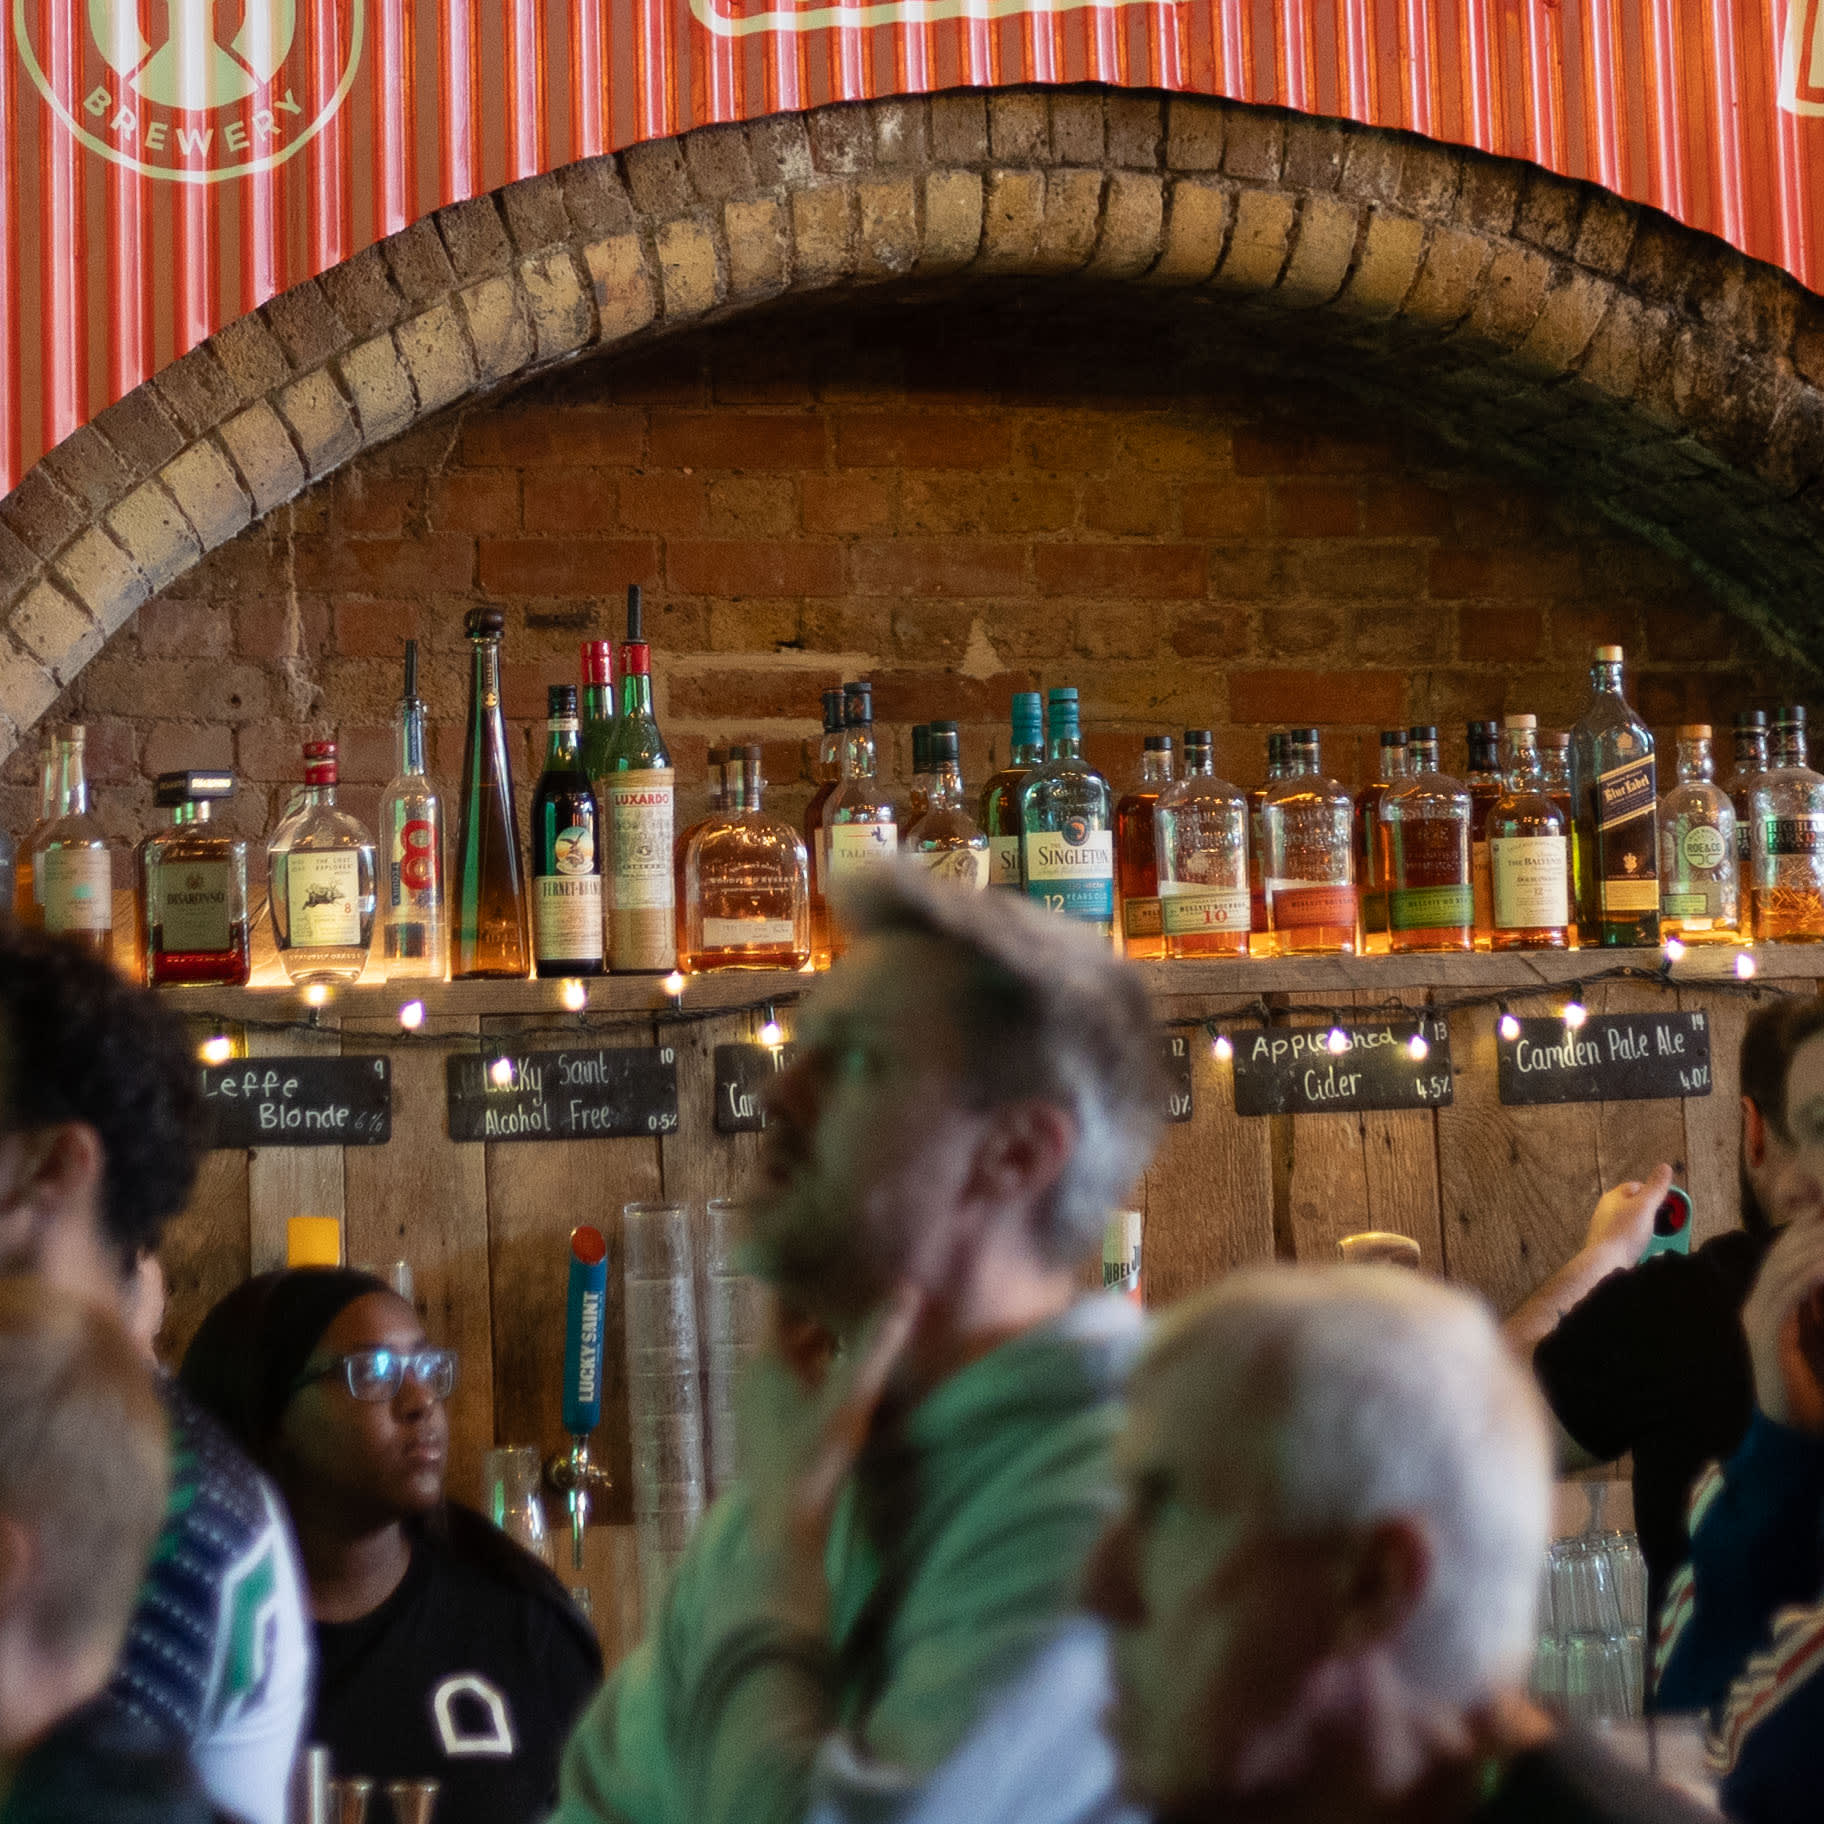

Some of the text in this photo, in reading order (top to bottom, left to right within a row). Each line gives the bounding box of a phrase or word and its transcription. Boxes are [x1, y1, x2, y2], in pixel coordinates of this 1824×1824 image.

[84, 86, 303, 157] BREWERY
[615, 793, 670, 805] LUXARDO
[1603, 775, 1650, 803] Blue Label
[1038, 847, 1108, 866] SINGLETON
[167, 892, 225, 905] DISARONNO
[344, 903, 352, 913] 8
[1044, 894, 1064, 912] 12
[1203, 910, 1227, 925] 10
[1434, 1022, 1448, 1041] 13
[1516, 1013, 1705, 1073] Camden Pale Ale 14
[1172, 1038, 1185, 1057] 12
[202, 1059, 384, 1098] Leffe 9
[558, 1050, 608, 1086] Saint
[660, 1048, 675, 1065] 10
[1304, 1065, 1452, 1101] Cider 4.5%
[259, 1102, 350, 1129] Blonde
[485, 1100, 678, 1135] Alcohol Free 0.5%
[579, 1291, 600, 1404] LUCKY SAINT
